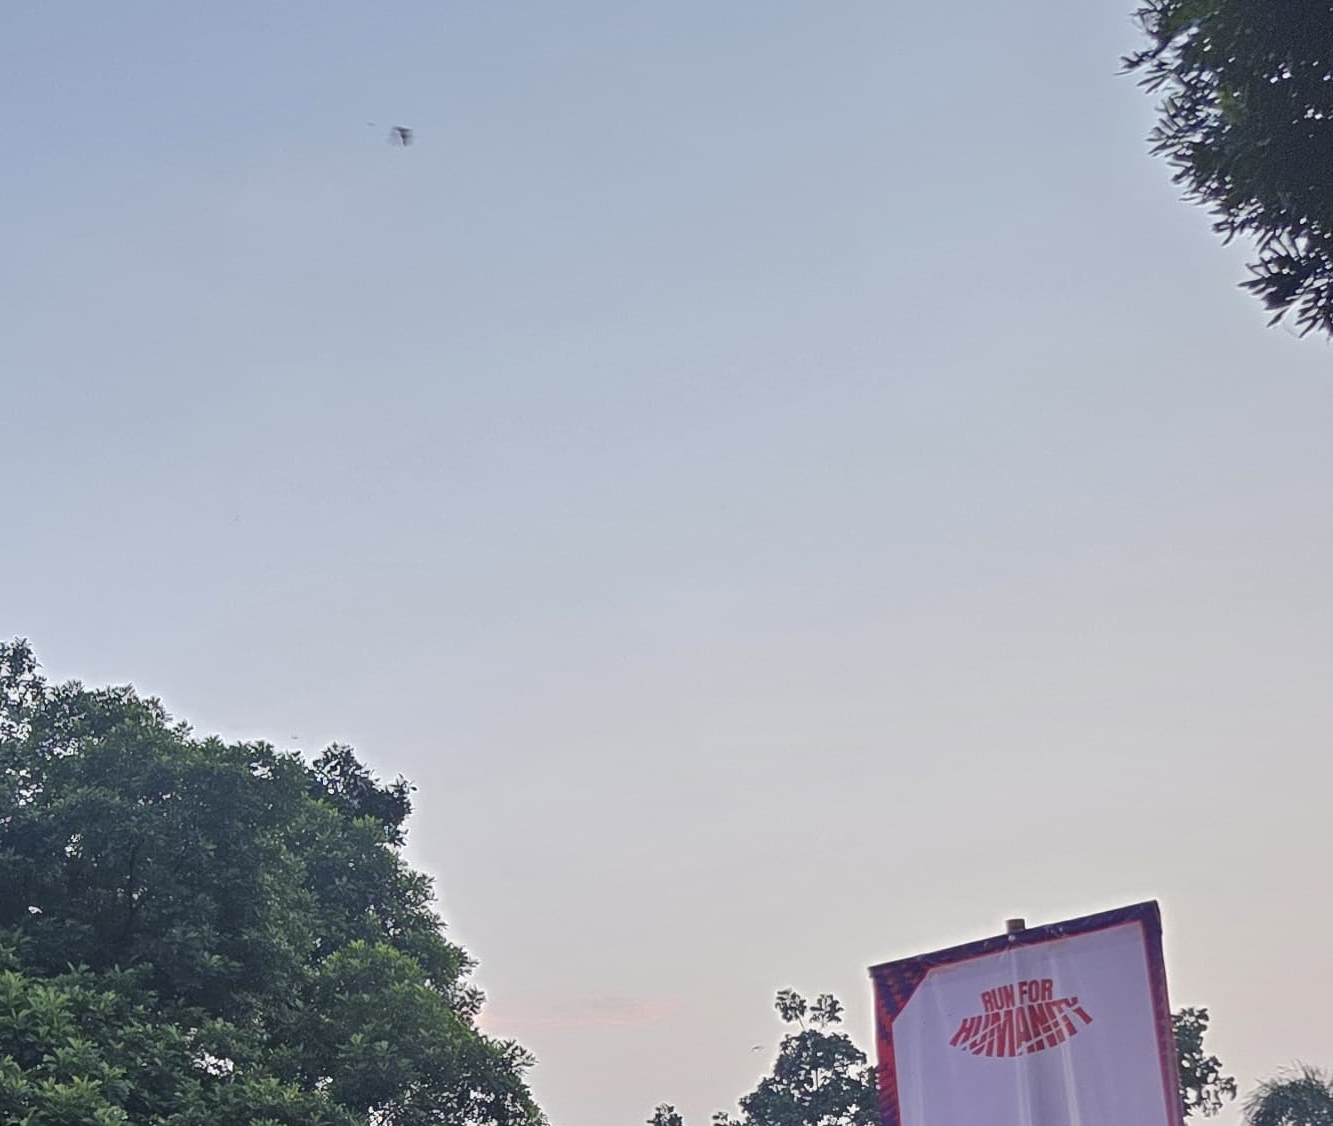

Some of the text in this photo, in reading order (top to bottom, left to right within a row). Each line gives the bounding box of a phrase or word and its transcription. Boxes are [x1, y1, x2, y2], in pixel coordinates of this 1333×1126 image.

[981, 979, 1053, 1012] RUN FOR
[949, 997, 1093, 1057] HUMANITY
